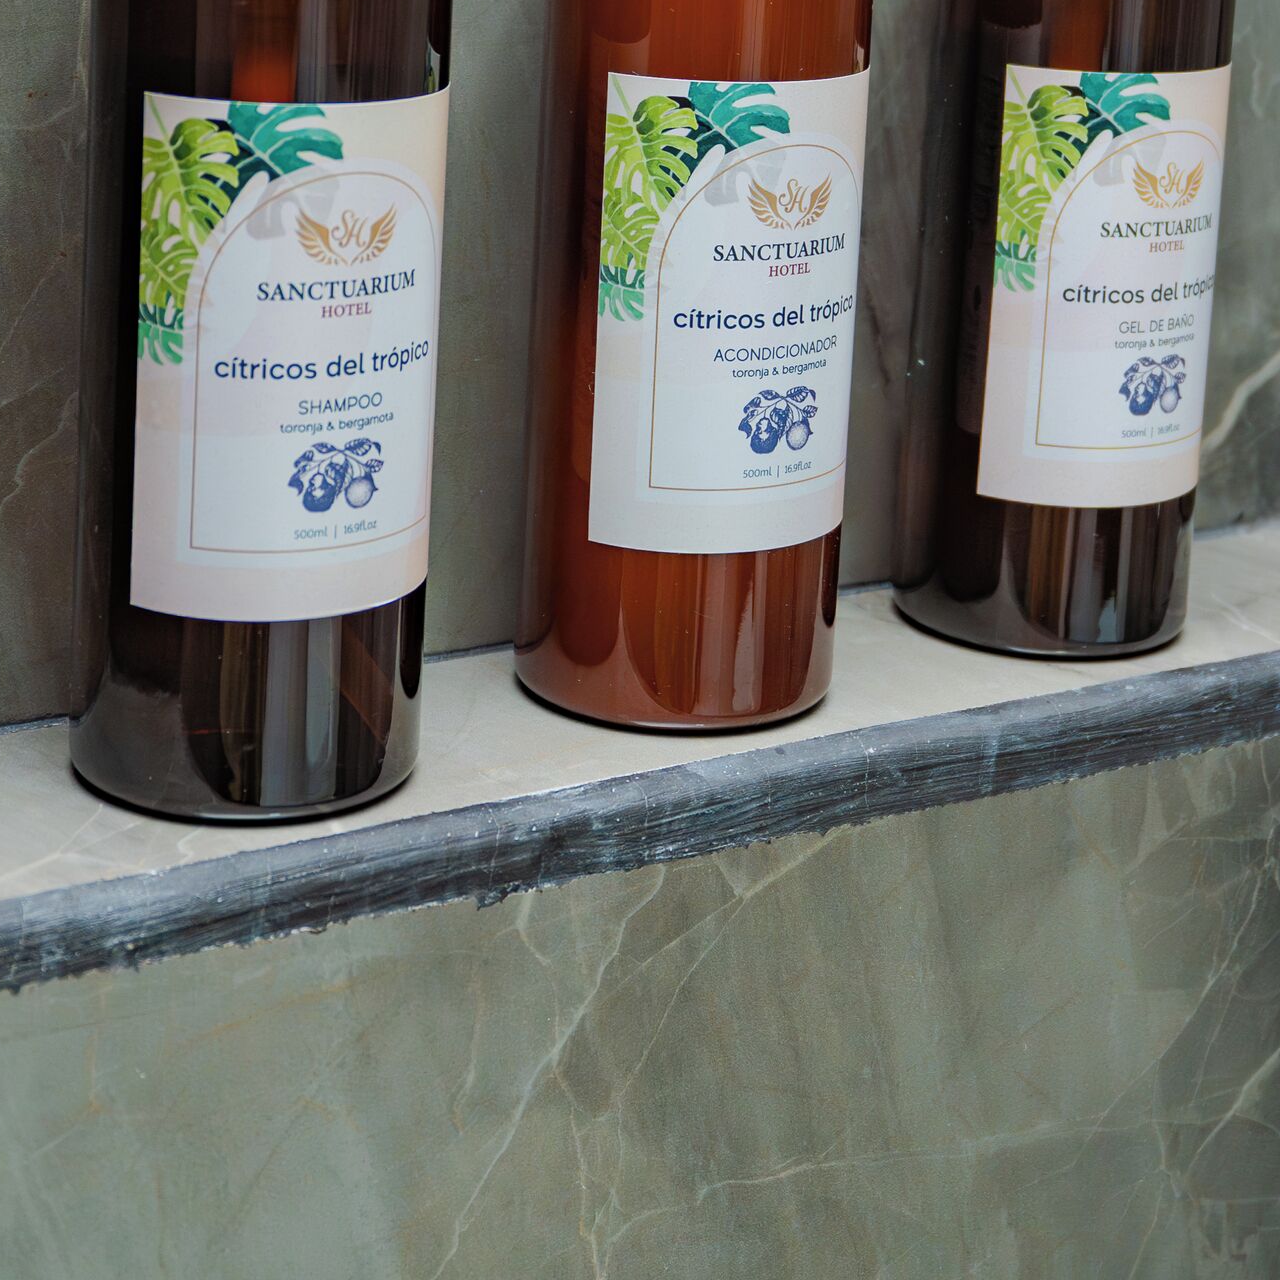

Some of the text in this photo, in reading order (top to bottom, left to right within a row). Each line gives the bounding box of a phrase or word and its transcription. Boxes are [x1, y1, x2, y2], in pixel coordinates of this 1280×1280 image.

[1100, 213, 1213, 238] SANCTUARIUM
[713, 233, 845, 262] SANCTUARIUM
[1149, 240, 1184, 253] HOTEL
[768, 262, 811, 277] HOTEL
[257, 269, 415, 301] SANCTUARIUM
[1062, 284, 1145, 304] cítricos
[1151, 282, 1178, 302] del
[321, 302, 373, 319] HOTEL
[673, 294, 853, 330] cítricos del trópico
[1118, 313, 1195, 334] GEL DE BAÑO
[713, 335, 838, 362] ACONDICIONADOR
[1114, 340, 1147, 350] toronja
[1149, 338, 1156, 347] &
[214, 340, 429, 380] cítricos del trópico
[732, 359, 827, 379] toronja & bergamota
[298, 392, 383, 415] SHAMPOO
[280, 412, 394, 436] toronja & bergamota
[743, 466, 772, 478] 500ml
[293, 525, 328, 540] 500ml
